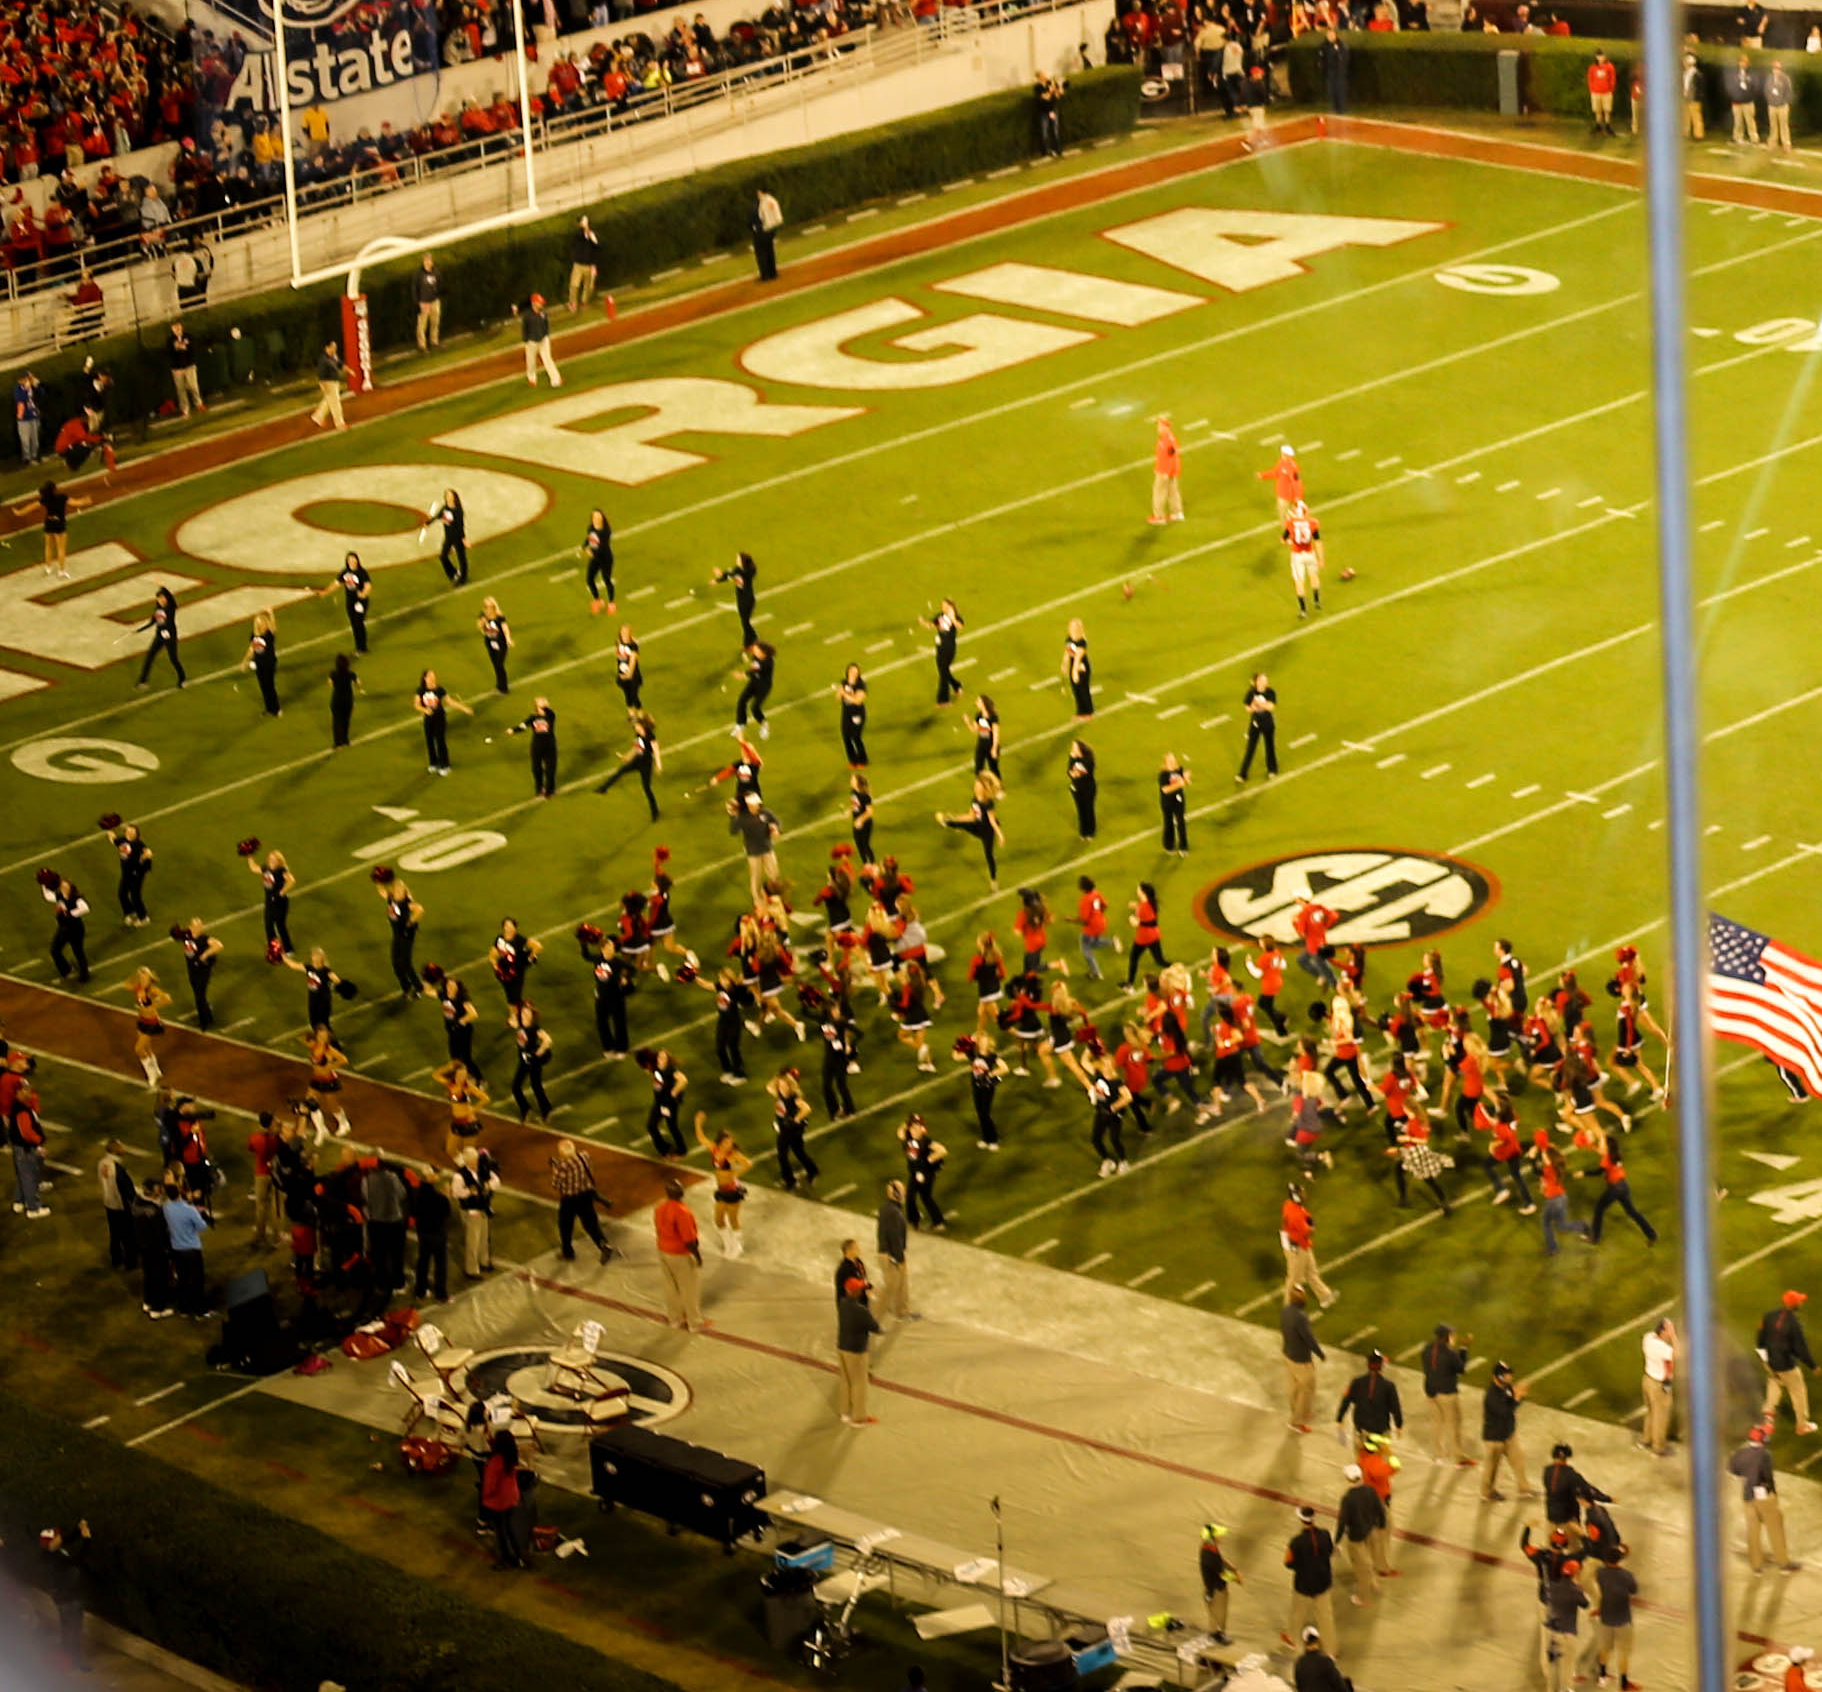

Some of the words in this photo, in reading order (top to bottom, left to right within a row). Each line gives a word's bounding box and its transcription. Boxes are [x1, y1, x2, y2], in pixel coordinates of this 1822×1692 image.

[225, 29, 415, 111] Allstate
[0, 205, 1450, 704] EORGIA
[10, 737, 160, 784] G
[352, 820, 507, 872] 10
[1217, 853, 1474, 946] SEC
